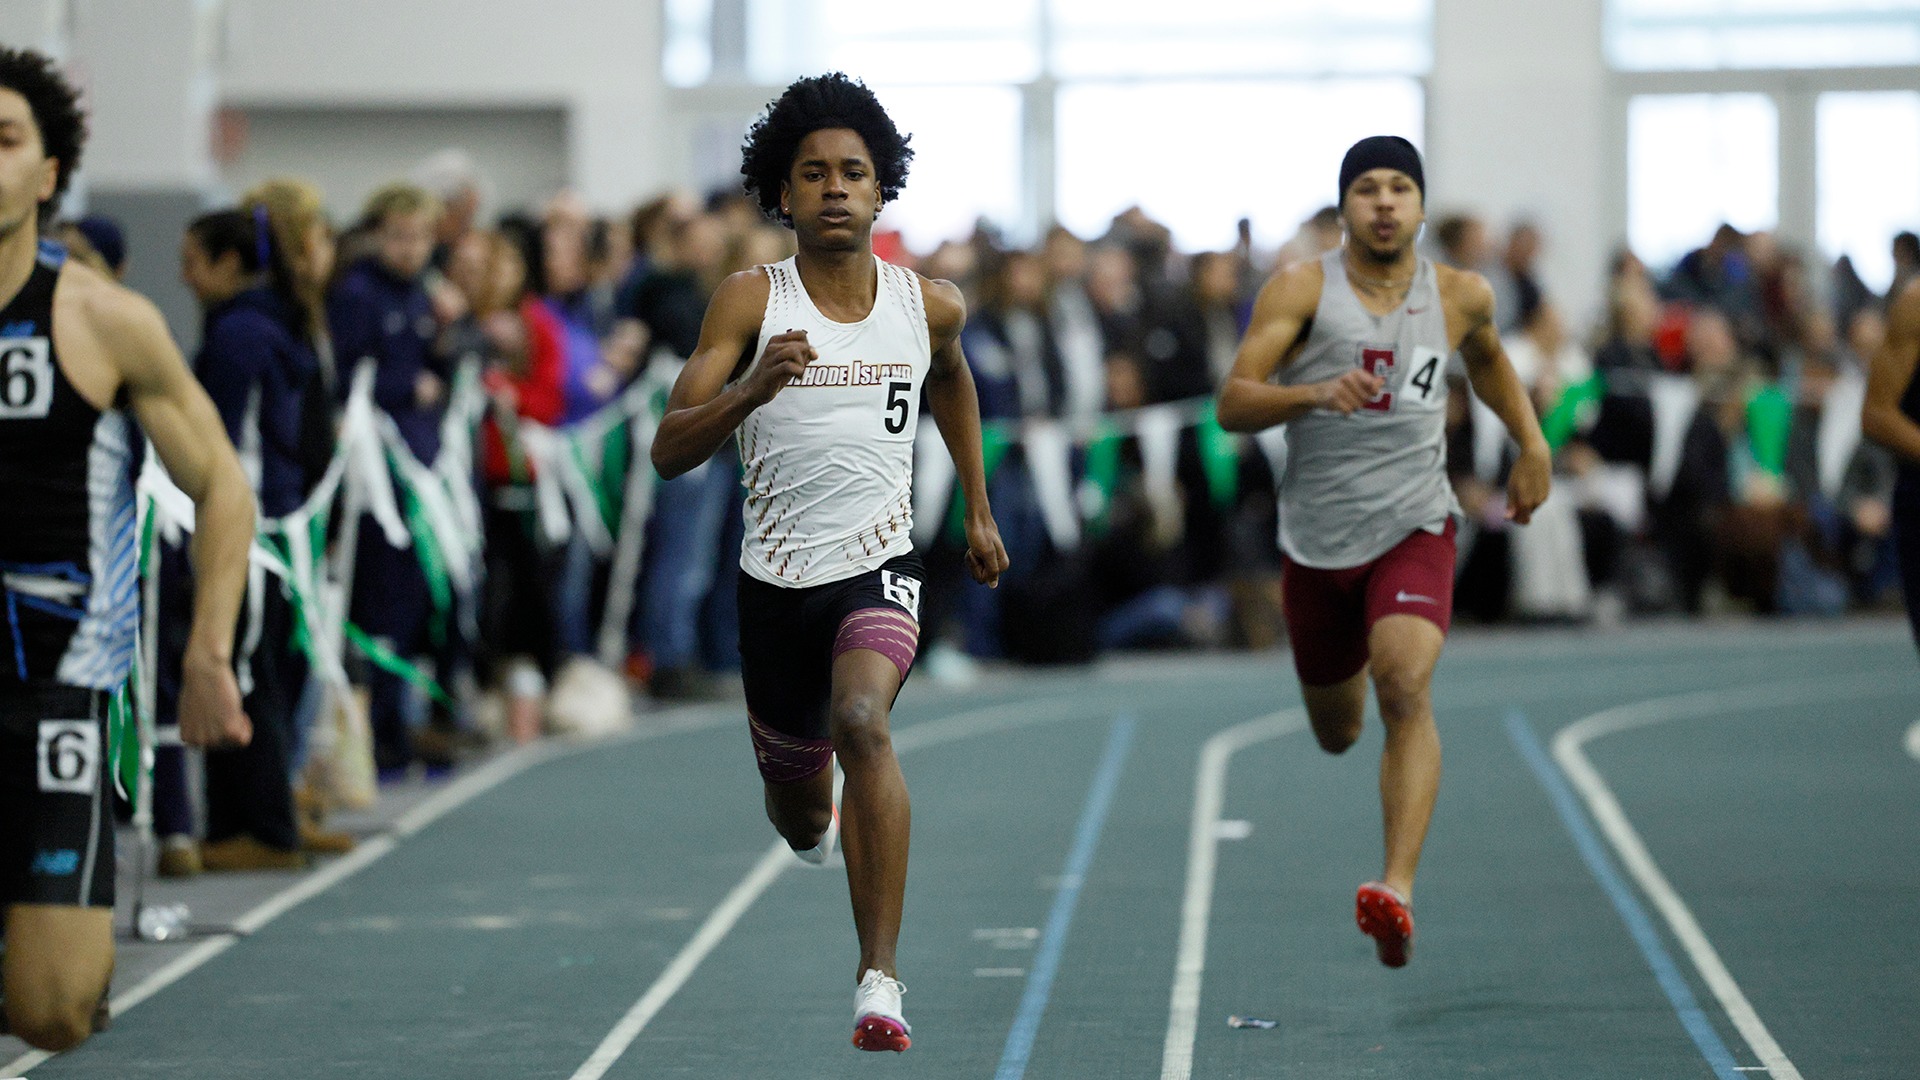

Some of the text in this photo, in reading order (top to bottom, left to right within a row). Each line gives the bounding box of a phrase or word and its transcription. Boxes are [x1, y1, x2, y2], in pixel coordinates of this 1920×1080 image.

[0, 347, 36, 408] 6
[1412, 357, 1438, 399] 4
[884, 381, 912, 434] 5
[49, 730, 86, 781] 6
